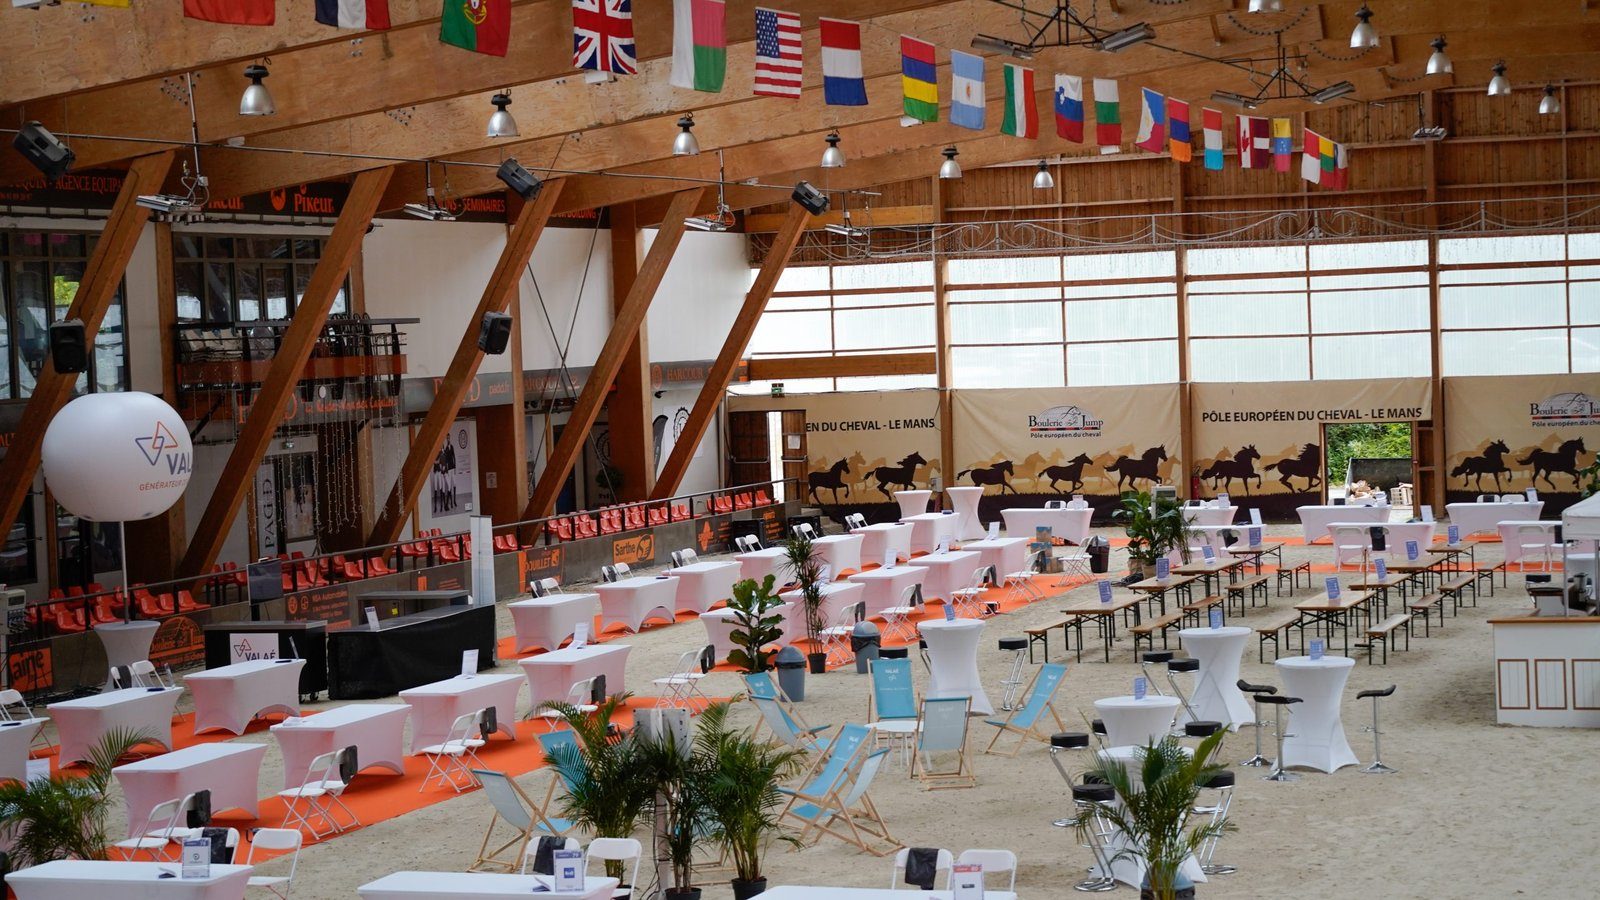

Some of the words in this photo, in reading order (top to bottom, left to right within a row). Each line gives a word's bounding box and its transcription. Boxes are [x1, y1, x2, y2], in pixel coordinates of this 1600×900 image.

[55, 175, 91, 191] AGENCE
[1081, 414, 1104, 430] Jump
[1202, 410, 1231, 422] PÔLE
[1233, 409, 1295, 422] EUROPÉEN
[1297, 410, 1315, 421] DU
[1317, 409, 1363, 420] CHEVAL
[1371, 408, 1385, 419] LE
[1387, 407, 1422, 418] MANS
[821, 422, 837, 432] DU
[839, 420, 881, 431] CHEVAL
[888, 419, 901, 430] LE
[903, 418, 935, 429] MANS
[615, 541, 636, 557] Sarthe
[245, 649, 276, 661] VALAÉ
